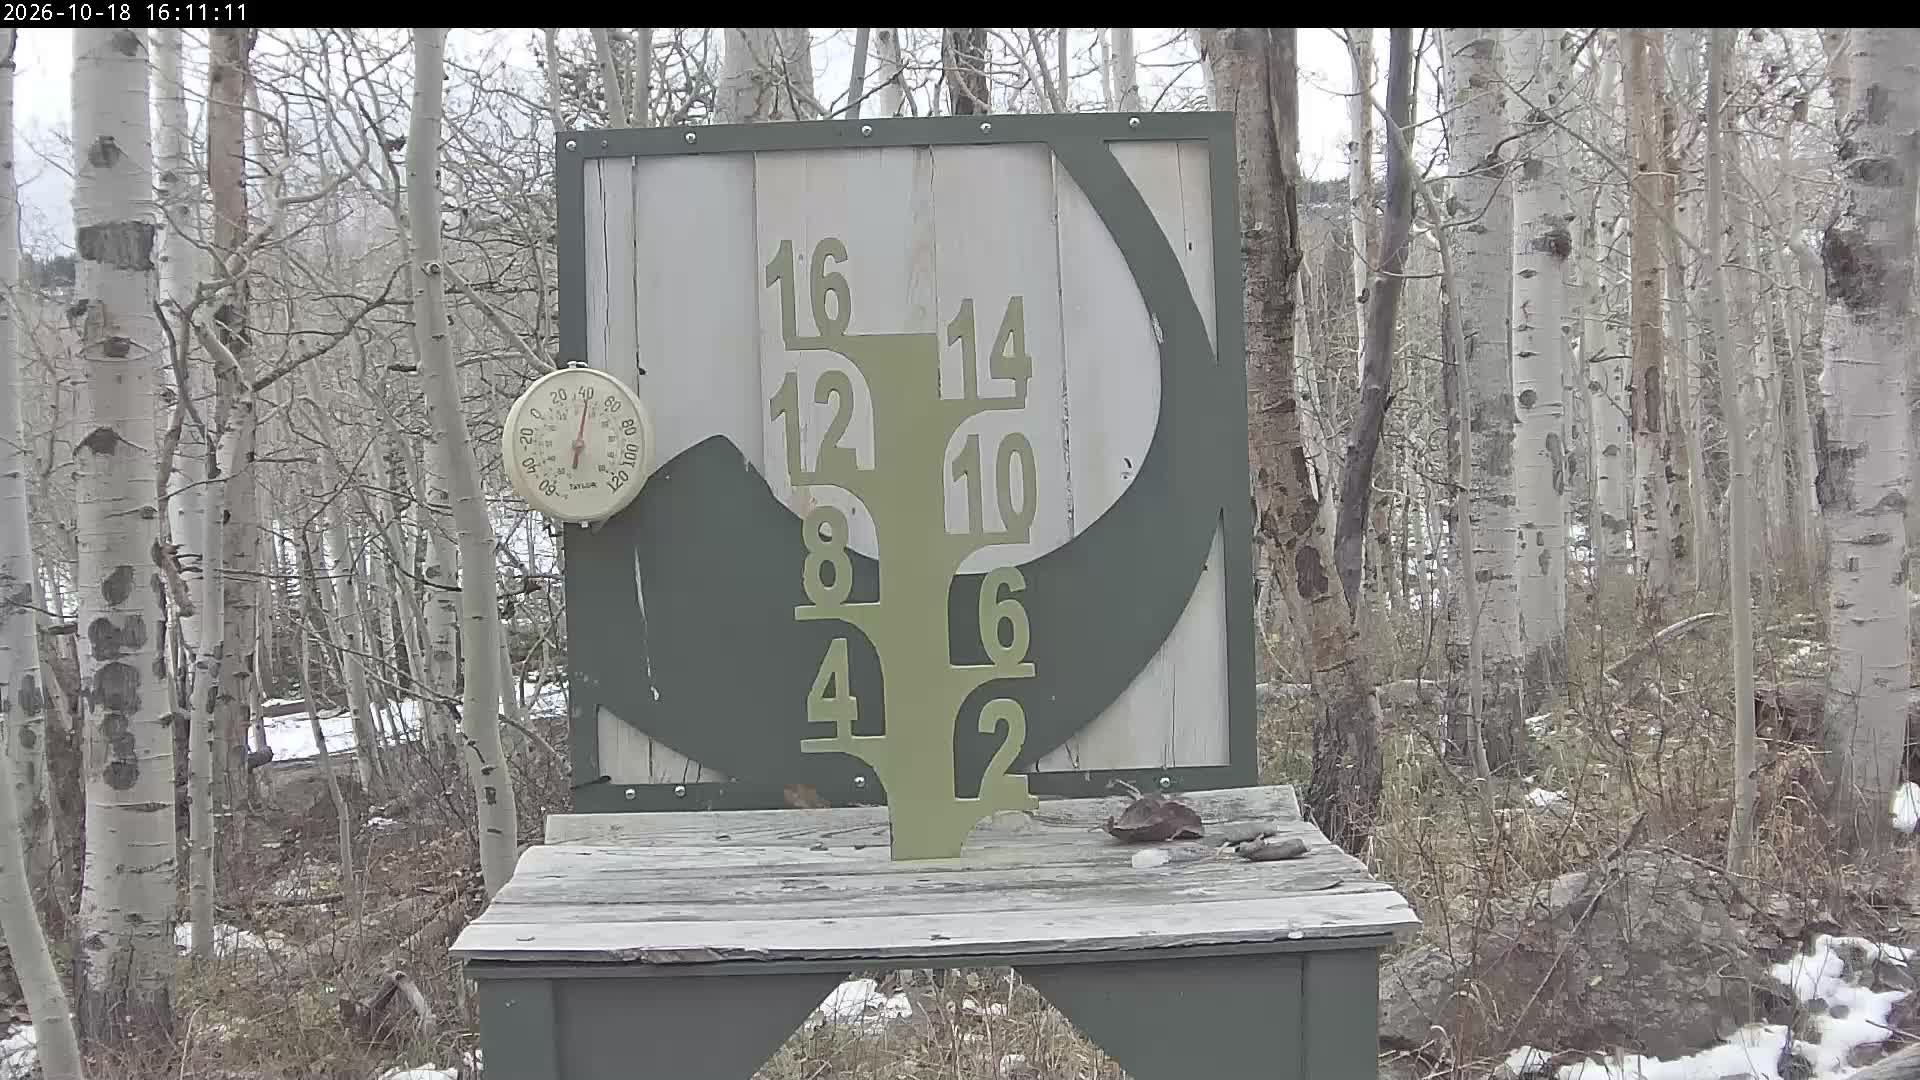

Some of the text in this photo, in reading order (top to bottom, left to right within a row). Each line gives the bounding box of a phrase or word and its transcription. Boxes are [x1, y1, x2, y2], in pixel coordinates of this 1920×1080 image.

[765, 237, 852, 346] 16
[946, 295, 1033, 407] 14
[530, 408, 541, 419] 0
[550, 388, 567, 404] 20
[578, 386, 594, 400] 40
[604, 396, 621, 413] 60
[621, 418, 637, 436] 80
[623, 443, 639, 468] 100
[769, 369, 857, 483] 12
[569, 482, 598, 490] TAYLOR
[606, 469, 629, 493] 120
[951, 432, 1038, 541] 10
[802, 504, 853, 608] 8
[978, 565, 1031, 667] 6
[806, 637, 859, 744] 4
[977, 698, 1031, 803] 2
